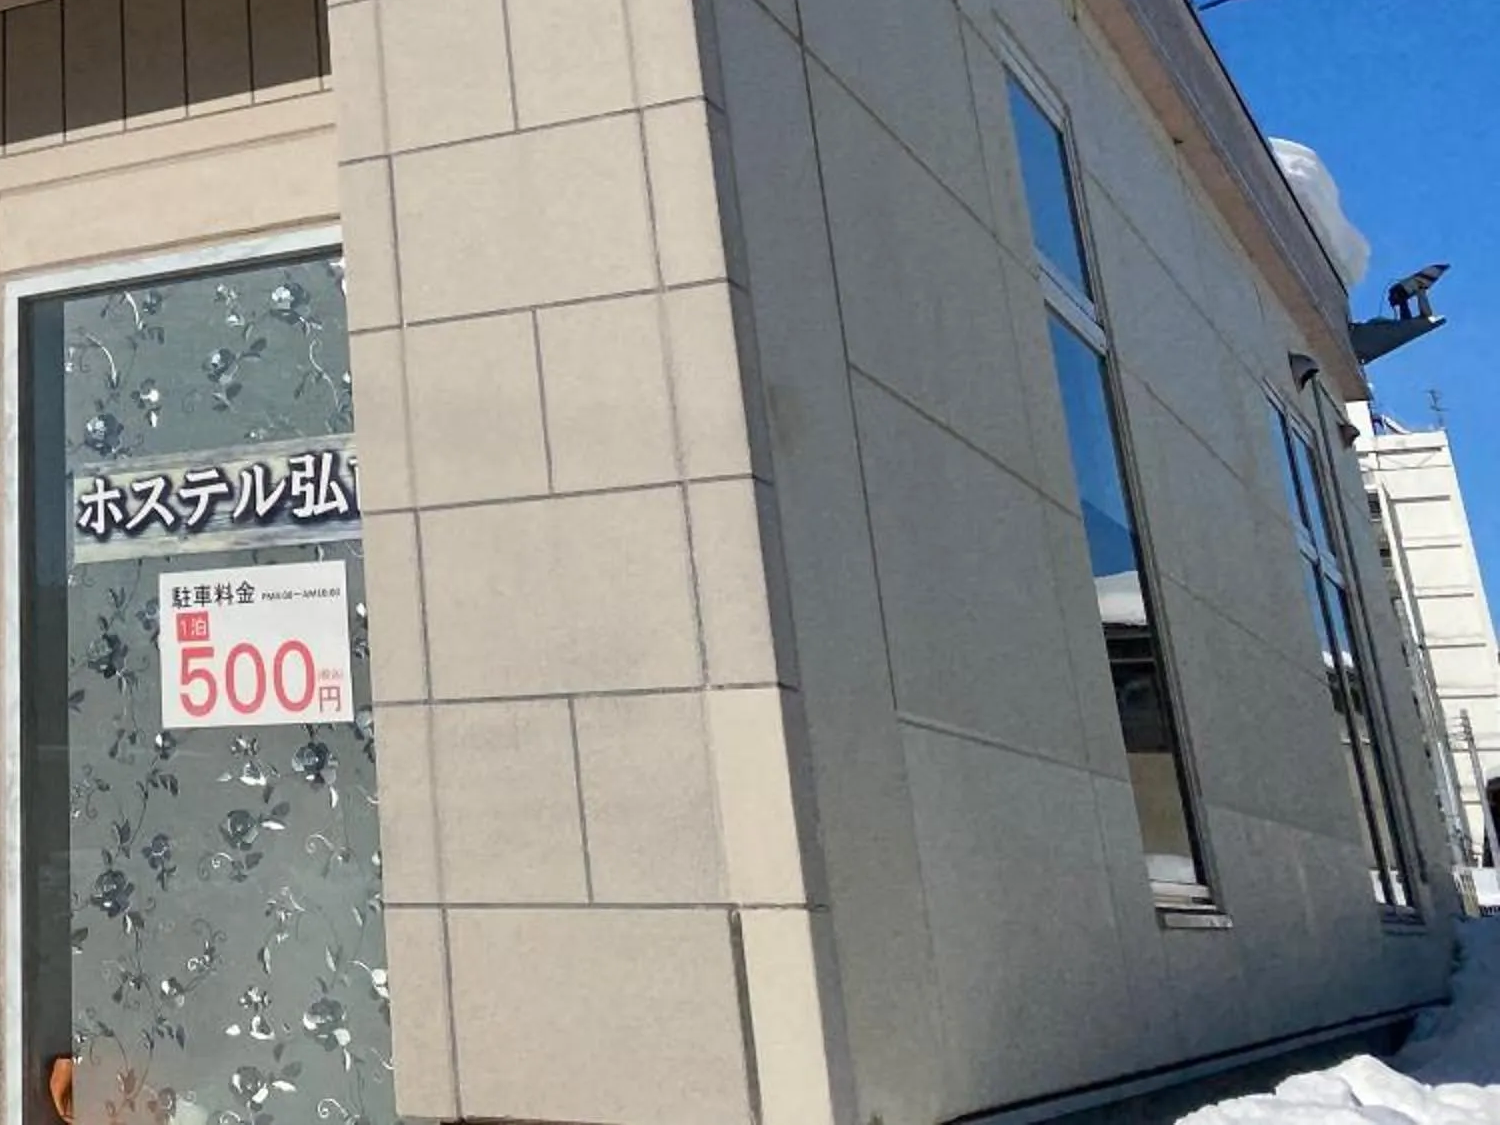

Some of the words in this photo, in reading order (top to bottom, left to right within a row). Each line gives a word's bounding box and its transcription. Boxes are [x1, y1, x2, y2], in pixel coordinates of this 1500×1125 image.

[77, 452, 361, 535] ホステル弘
[172, 580, 255, 609] 駐車料金
[179, 617, 207, 636] 1泊
